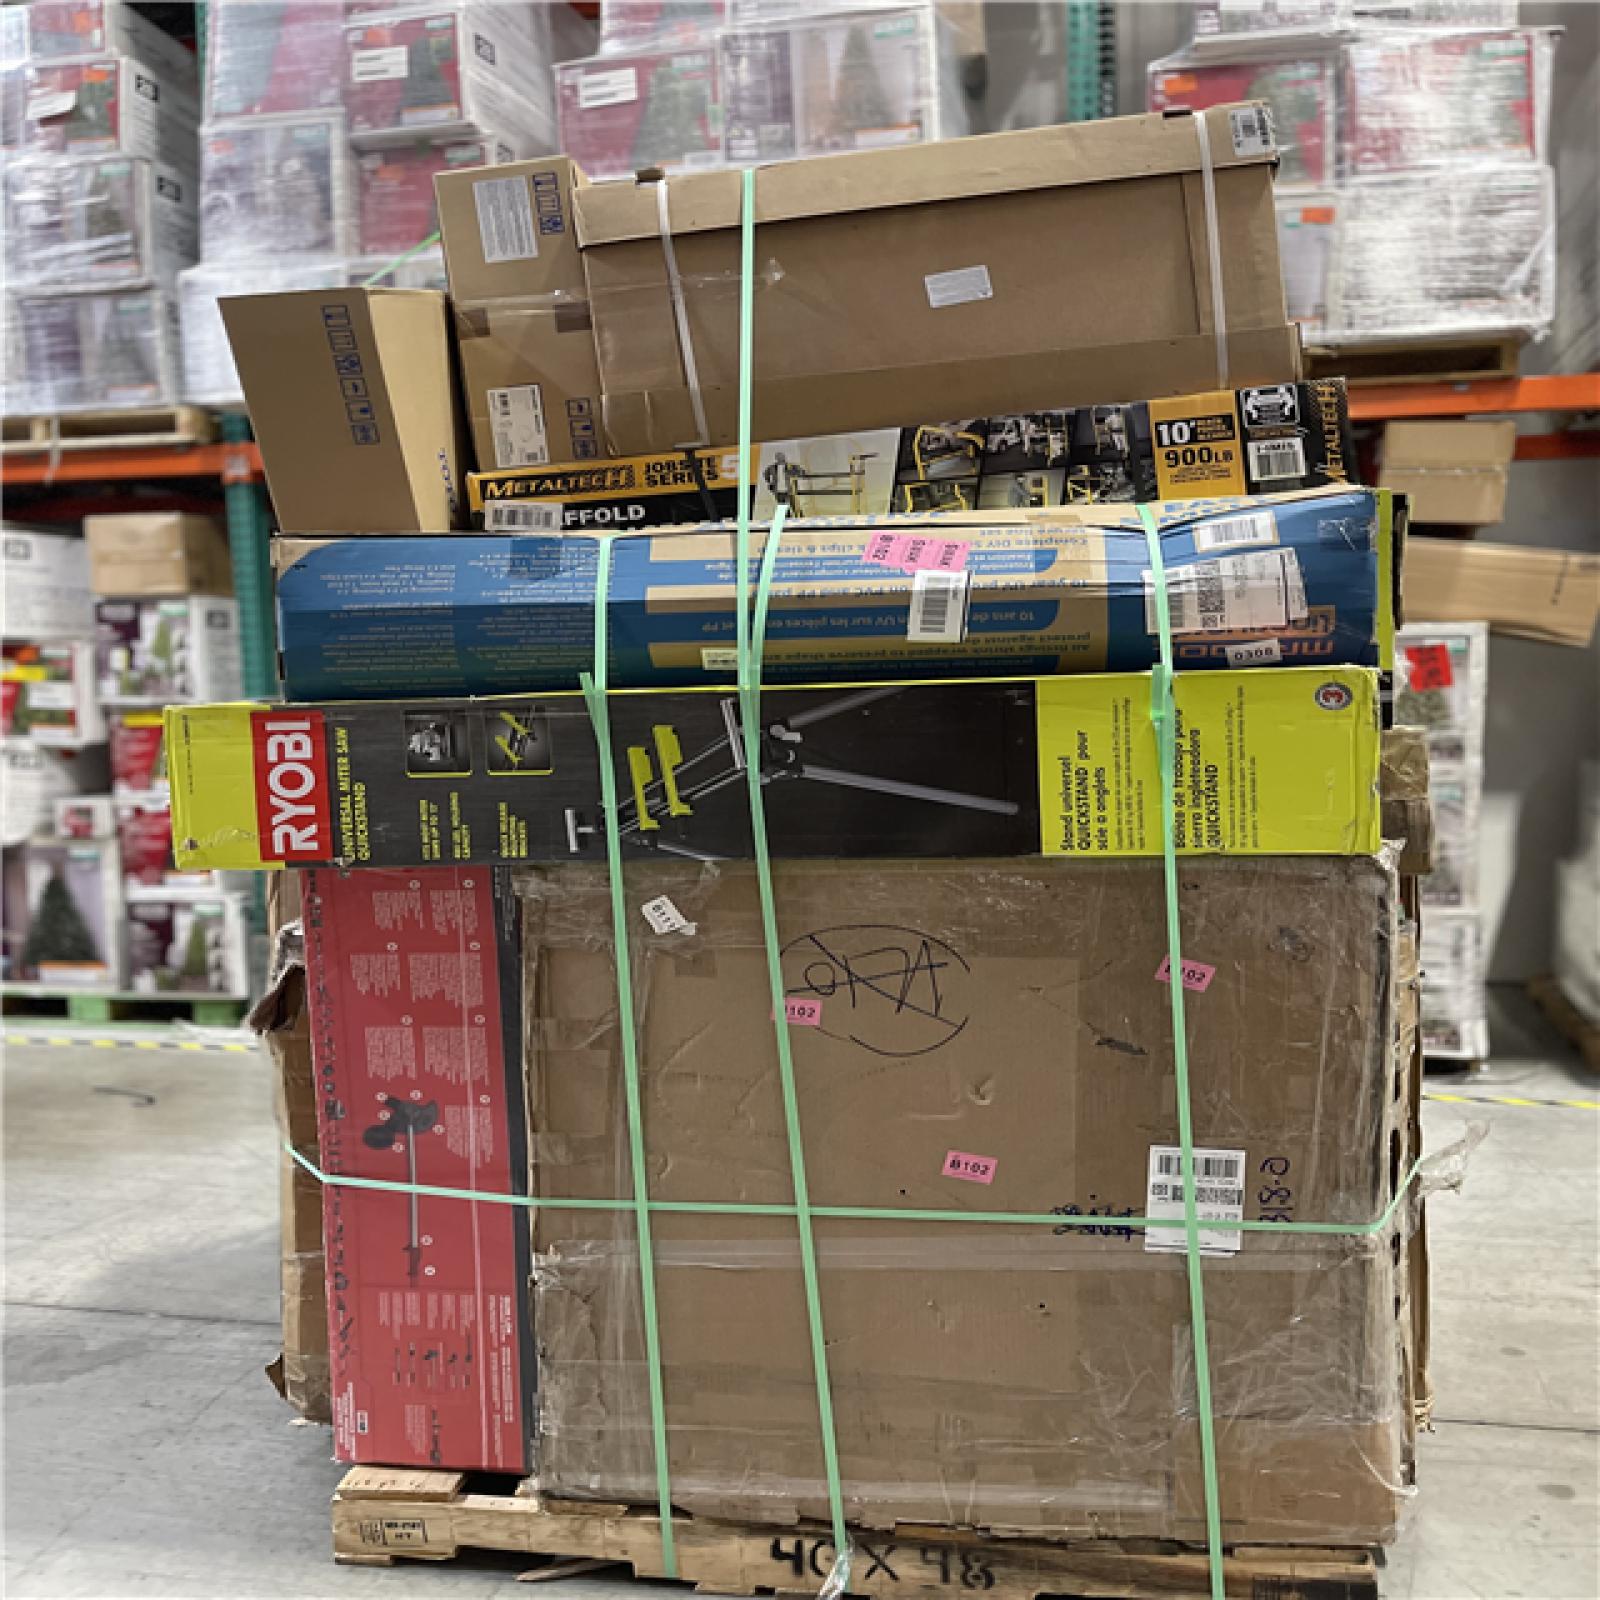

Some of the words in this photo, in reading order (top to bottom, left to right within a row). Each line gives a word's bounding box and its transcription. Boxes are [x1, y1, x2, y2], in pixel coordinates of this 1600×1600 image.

[645, 456, 717, 473] JOBSTE
[487, 469, 626, 497] METALTECH
[646, 470, 719, 488] SERIS
[562, 503, 646, 527] FFOLD
[265, 720, 318, 854] RYOBI
[783, 1003, 817, 1019] 102
[860, 1542, 900, 1582] X
[920, 1543, 997, 1591] 48
